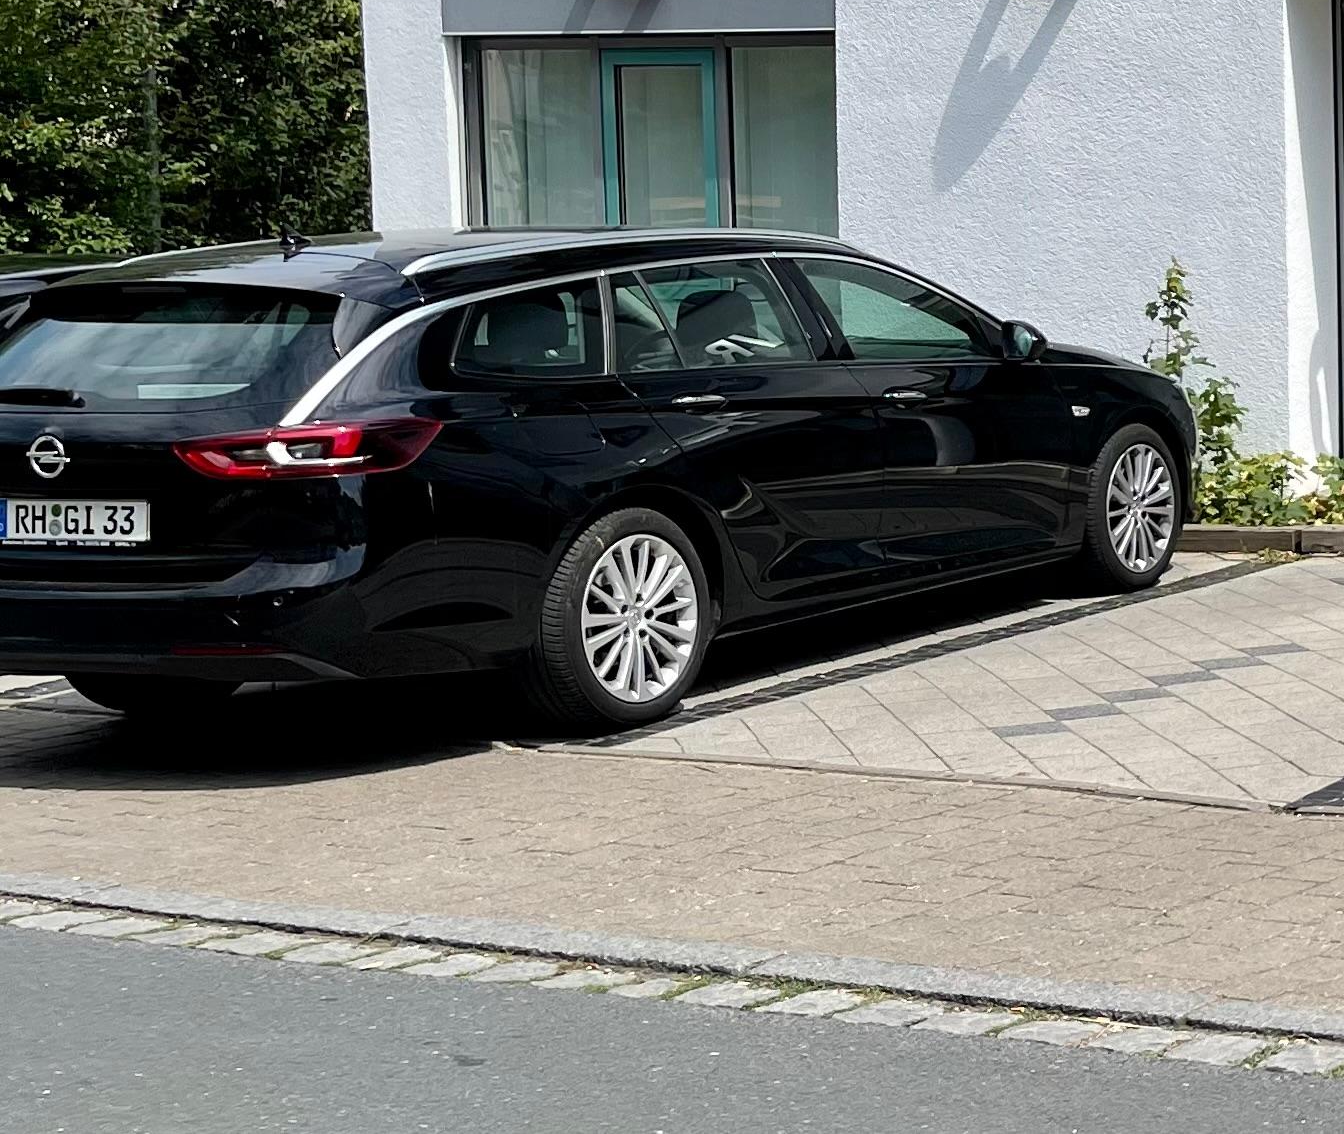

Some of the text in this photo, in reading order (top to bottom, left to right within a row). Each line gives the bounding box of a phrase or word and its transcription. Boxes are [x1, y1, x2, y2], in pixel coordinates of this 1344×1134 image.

[15, 504, 135, 535] RH GI 33
